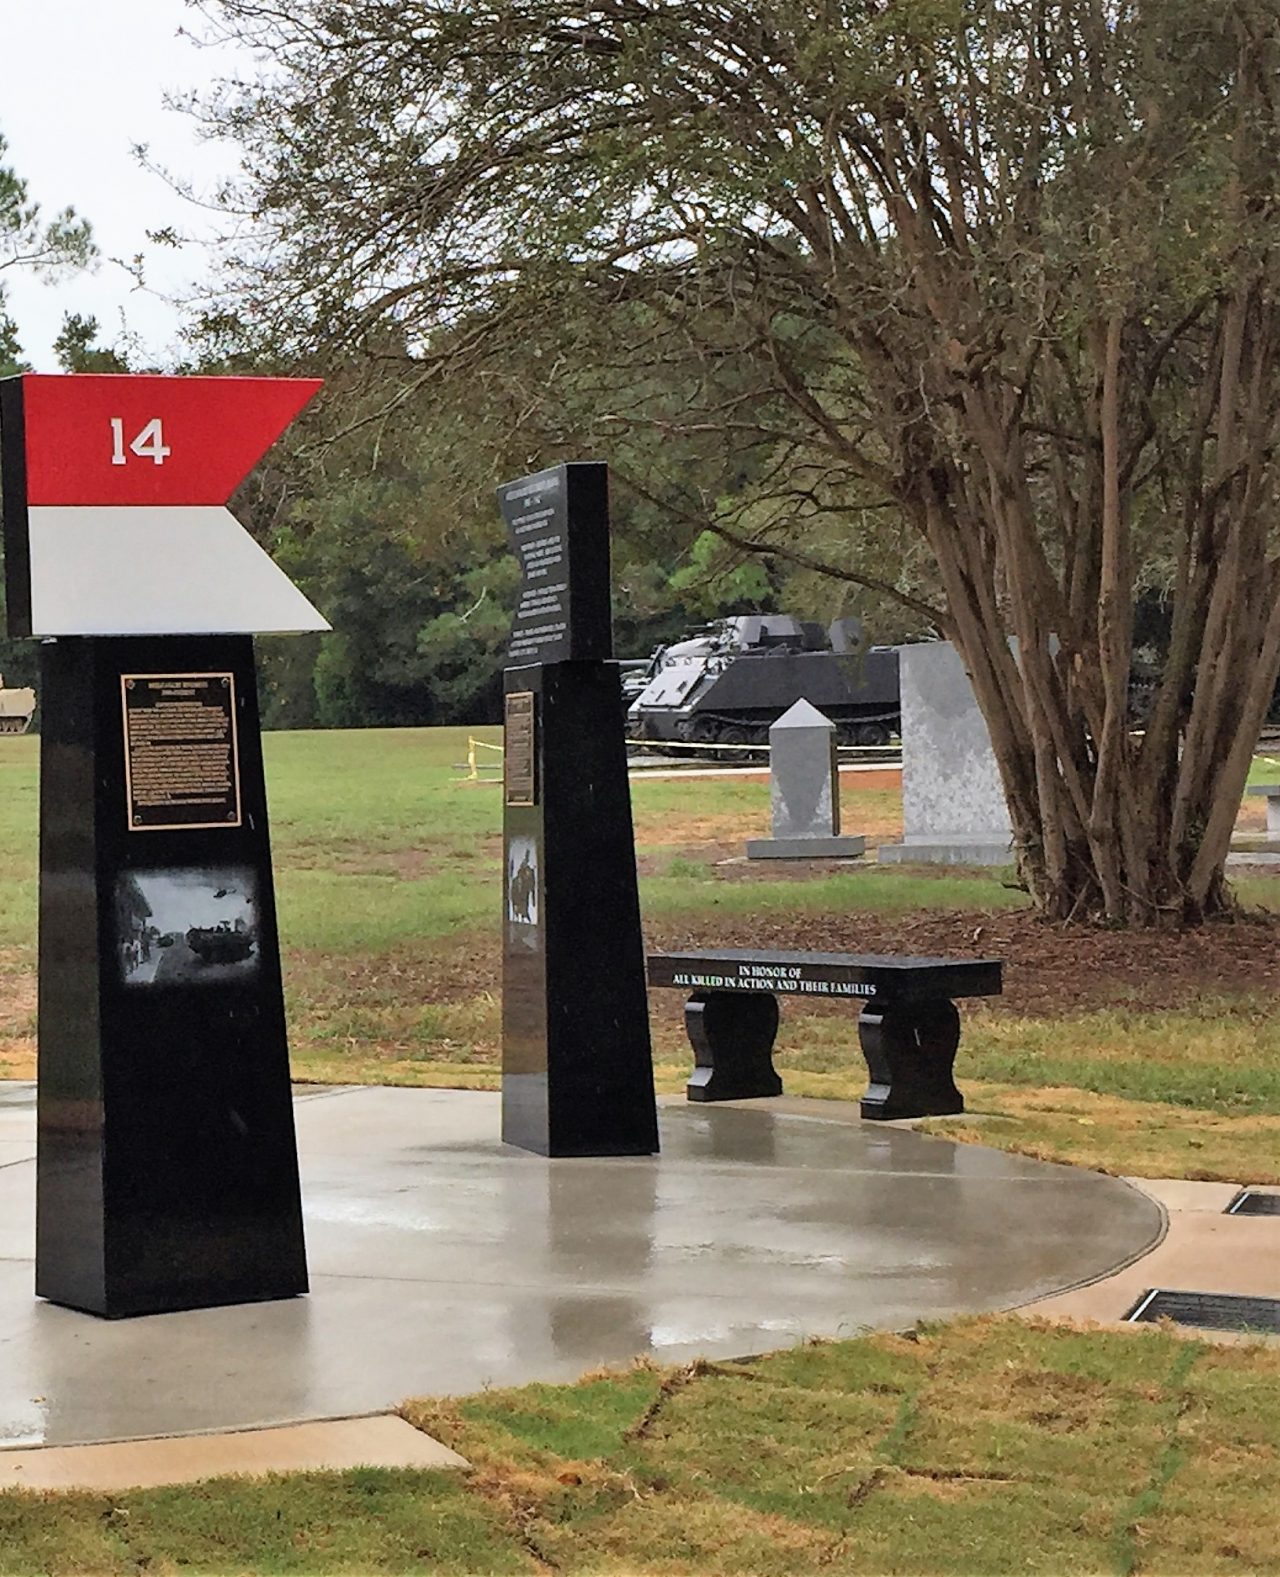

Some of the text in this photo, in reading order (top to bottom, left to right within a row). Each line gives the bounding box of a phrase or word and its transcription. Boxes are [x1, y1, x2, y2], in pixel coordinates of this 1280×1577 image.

[110, 417, 171, 465] 14
[738, 965, 802, 979] IN HONOR OF
[673, 974, 876, 996] ALL KILLED IN ACTION AND THEIR FAMILIES
